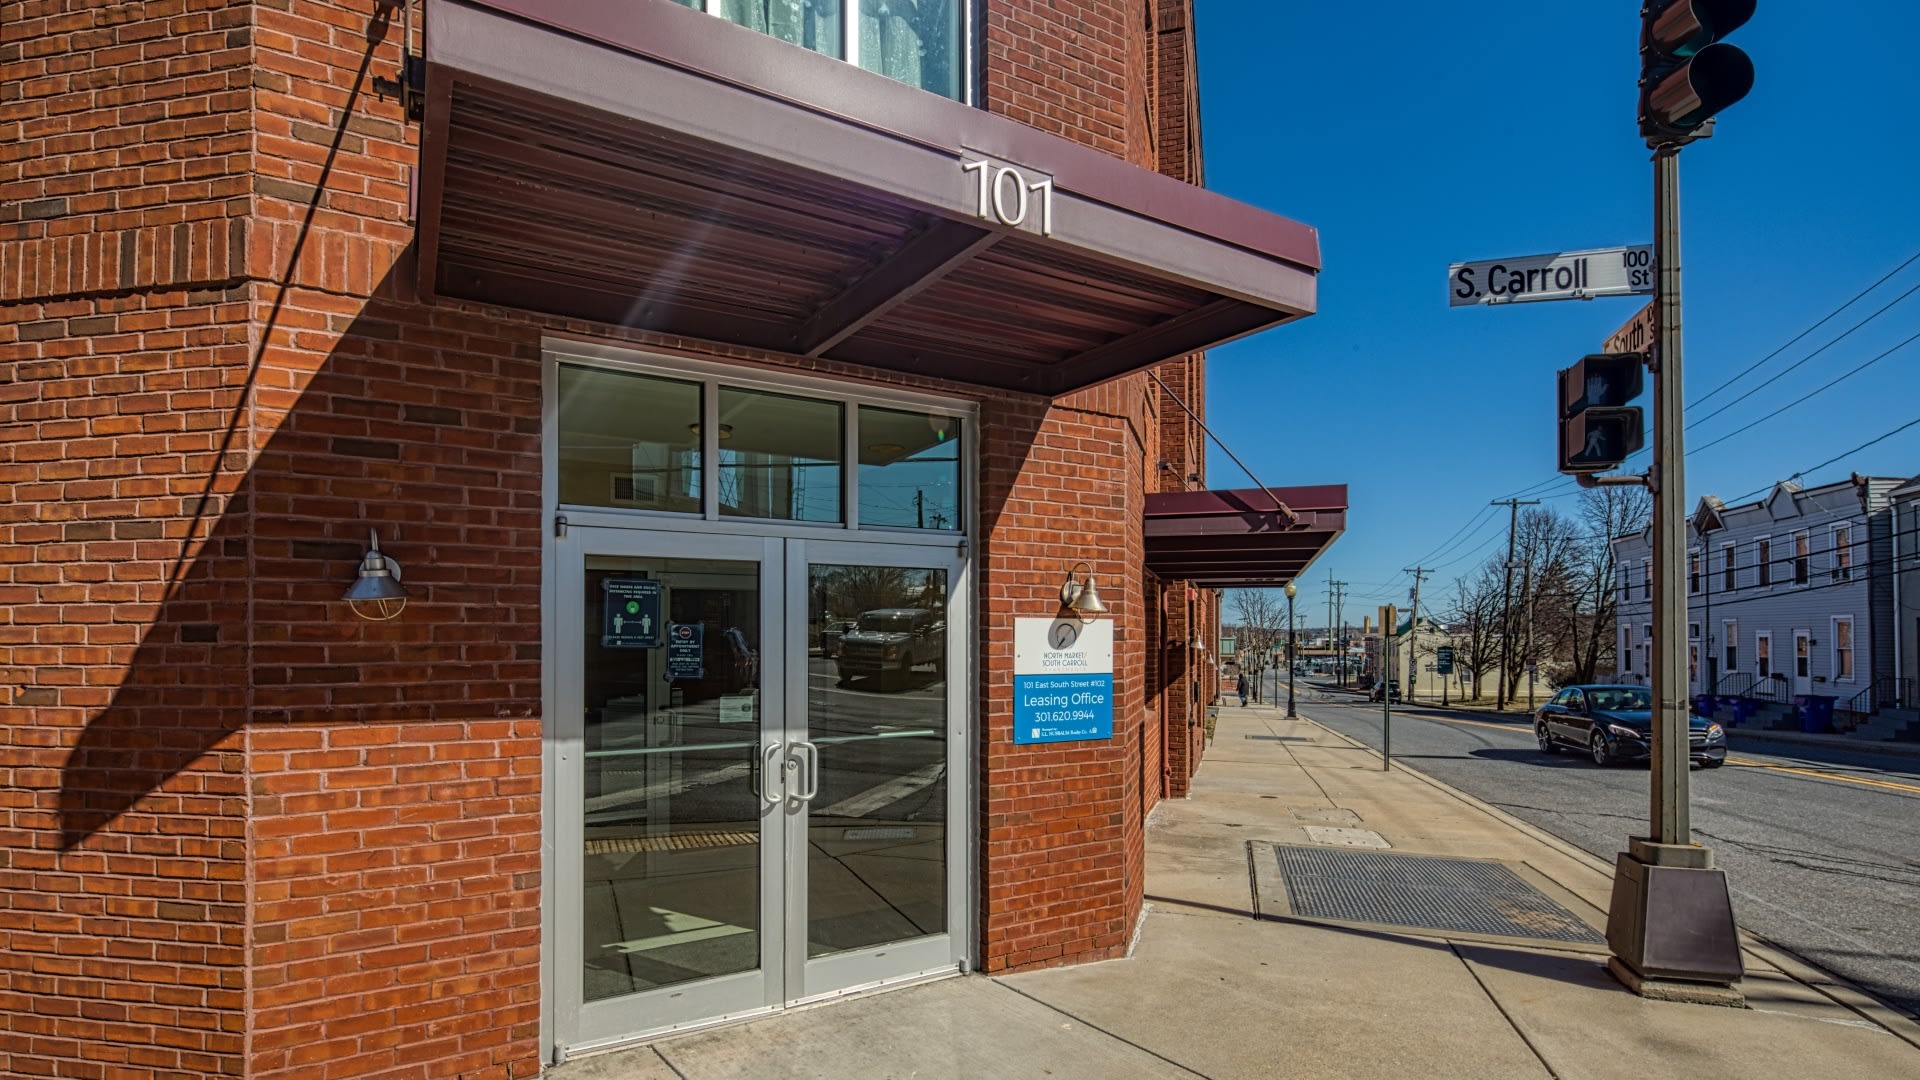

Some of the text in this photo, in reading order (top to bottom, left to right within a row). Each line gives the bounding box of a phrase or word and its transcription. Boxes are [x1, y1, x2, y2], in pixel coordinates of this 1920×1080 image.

[962, 160, 1052, 237] 101
[1456, 250, 1649, 299] S. Carroll 100
[1631, 269, 1649, 286] St
[1613, 318, 1644, 353] South
[1042, 659, 1088, 667] SOUTH CARROLL
[1070, 680, 1090, 688] Street
[1090, 680, 1105, 688] #102
[1024, 692, 1105, 708] Leasing Office
[1035, 710, 1095, 723] 301.620.9944
